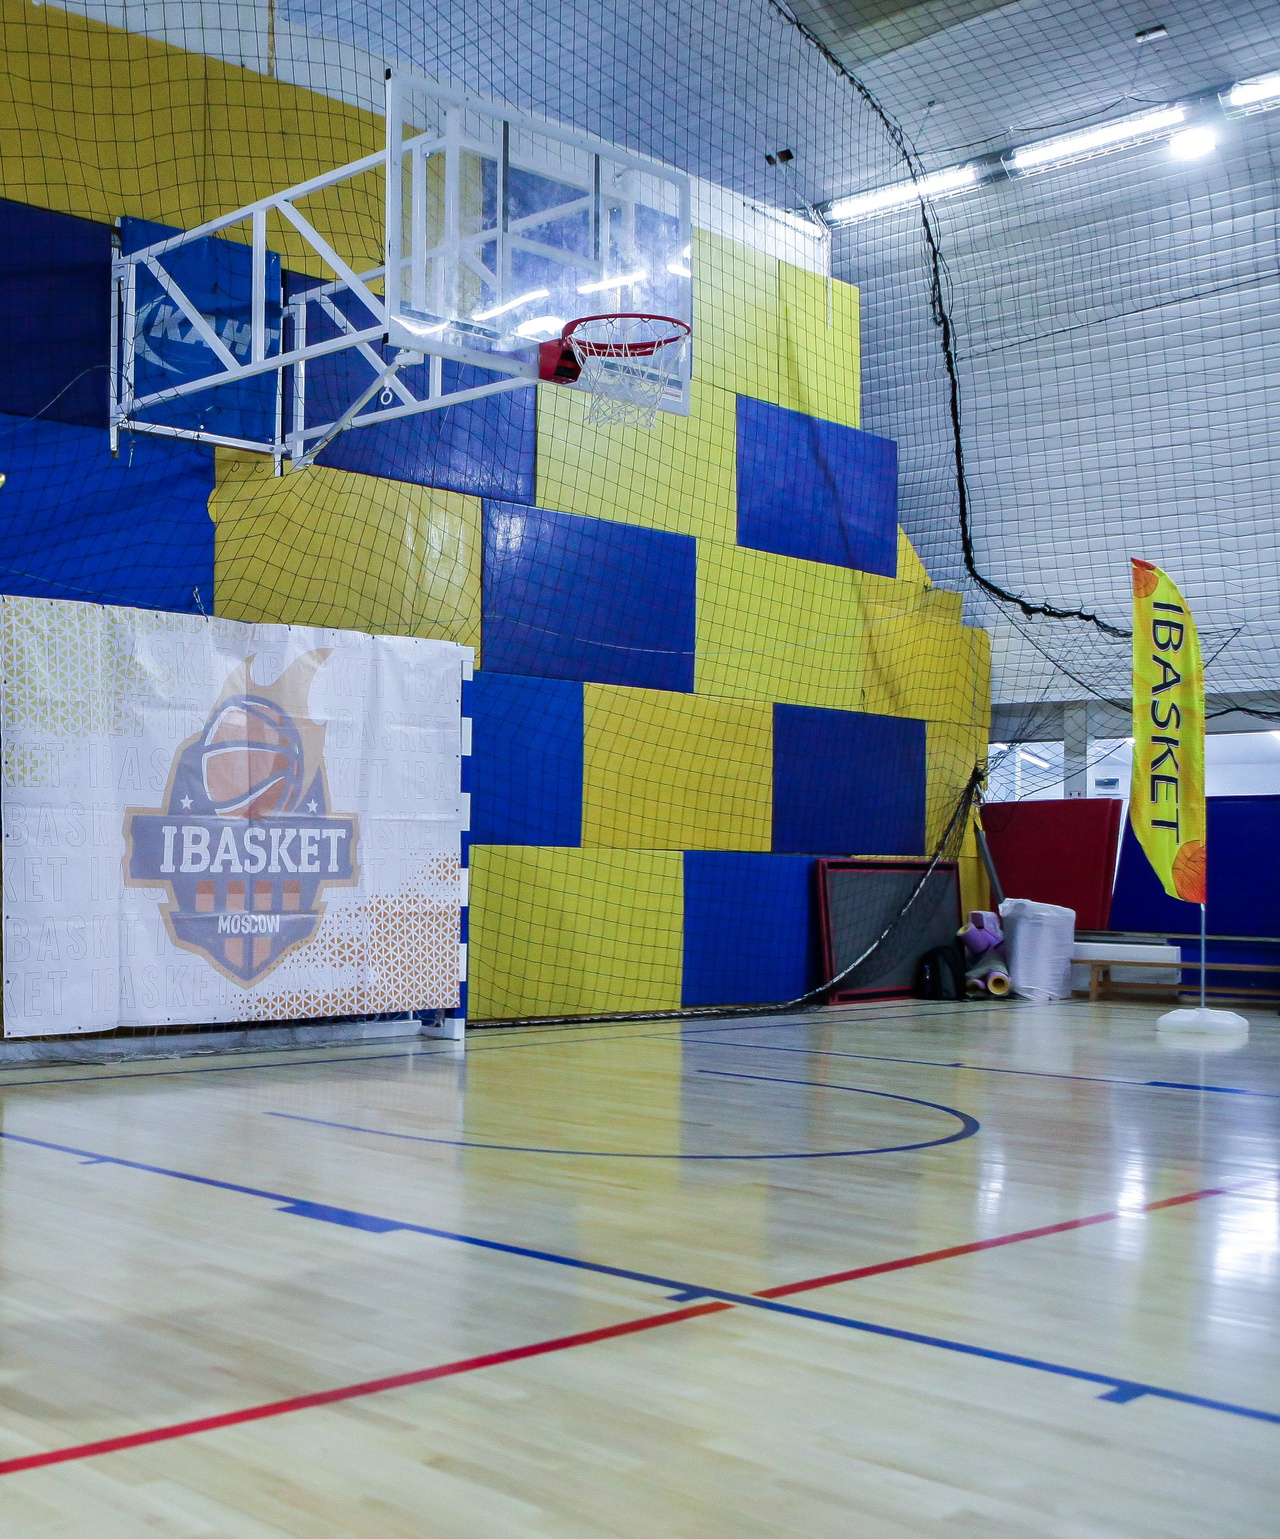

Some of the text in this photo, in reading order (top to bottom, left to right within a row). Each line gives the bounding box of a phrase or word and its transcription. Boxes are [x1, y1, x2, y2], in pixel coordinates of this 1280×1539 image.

[1150, 602, 1185, 845] IBASKET
[160, 826, 346, 873] IBASKET
[218, 914, 280, 934] MOSCOW
